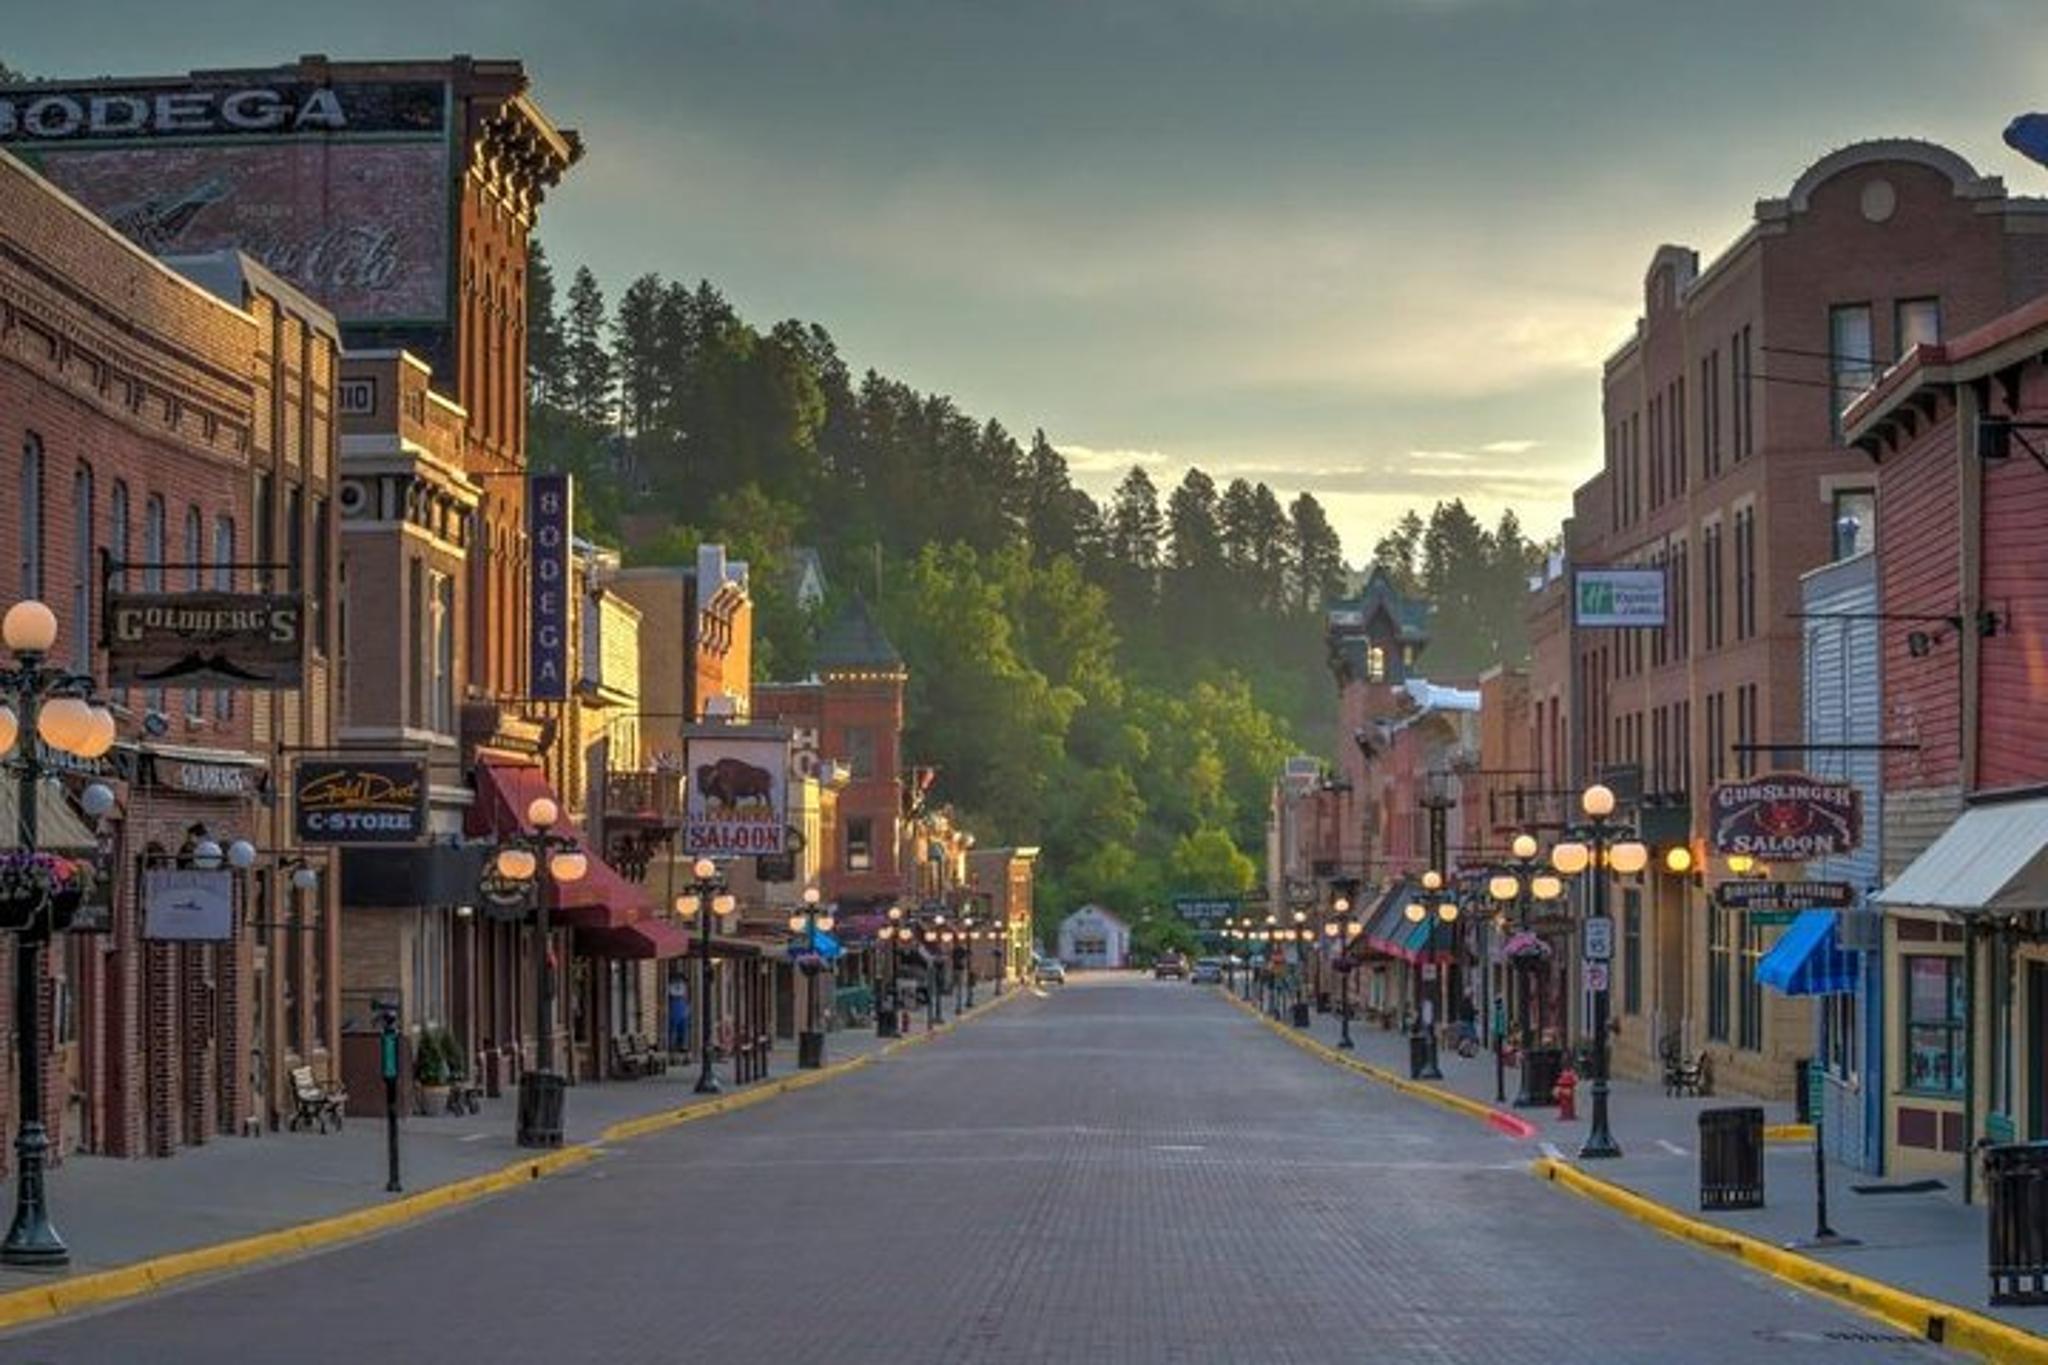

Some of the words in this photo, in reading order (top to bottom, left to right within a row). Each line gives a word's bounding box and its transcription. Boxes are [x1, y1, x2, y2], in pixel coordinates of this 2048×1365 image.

[540, 492, 559, 682] BODEGA
[690, 826, 782, 850] SALOON
[1733, 835, 1834, 852] SALOON
